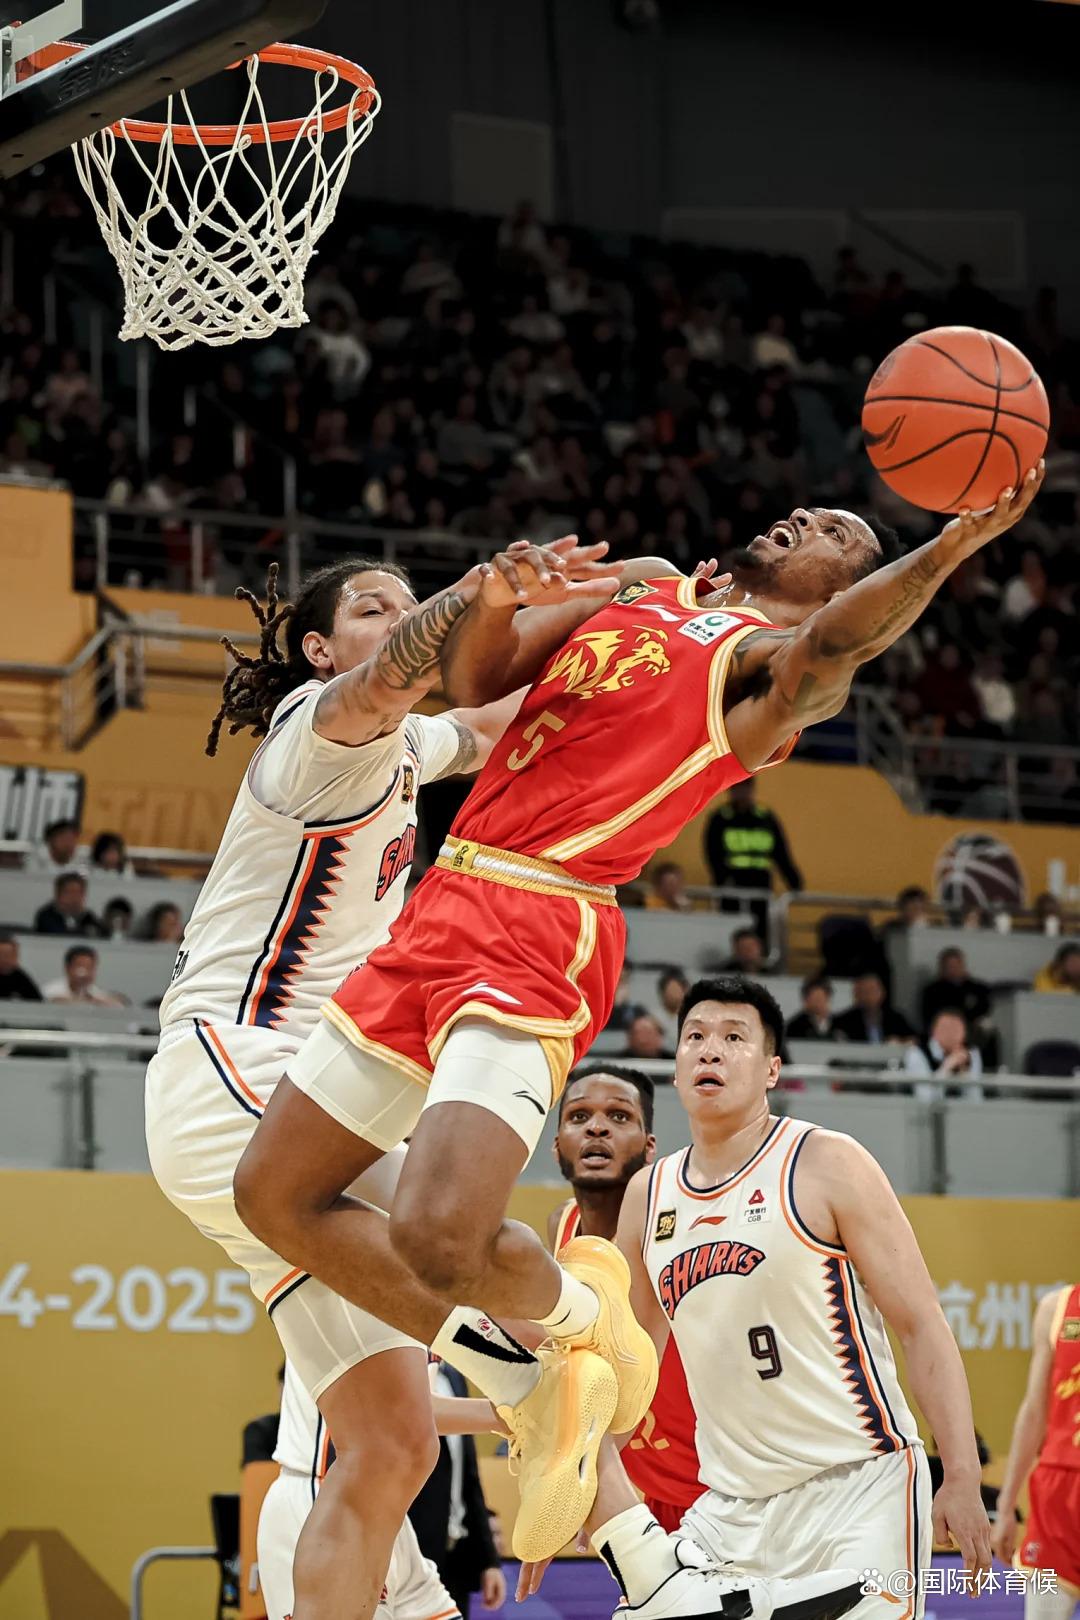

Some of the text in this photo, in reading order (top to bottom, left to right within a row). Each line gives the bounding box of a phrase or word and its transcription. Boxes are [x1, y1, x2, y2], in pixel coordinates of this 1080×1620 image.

[506, 710, 566, 771] 5
[747, 1215, 762, 1223] CGB
[658, 1240, 766, 1321] SHARKS
[747, 1325, 783, 1381] 9
